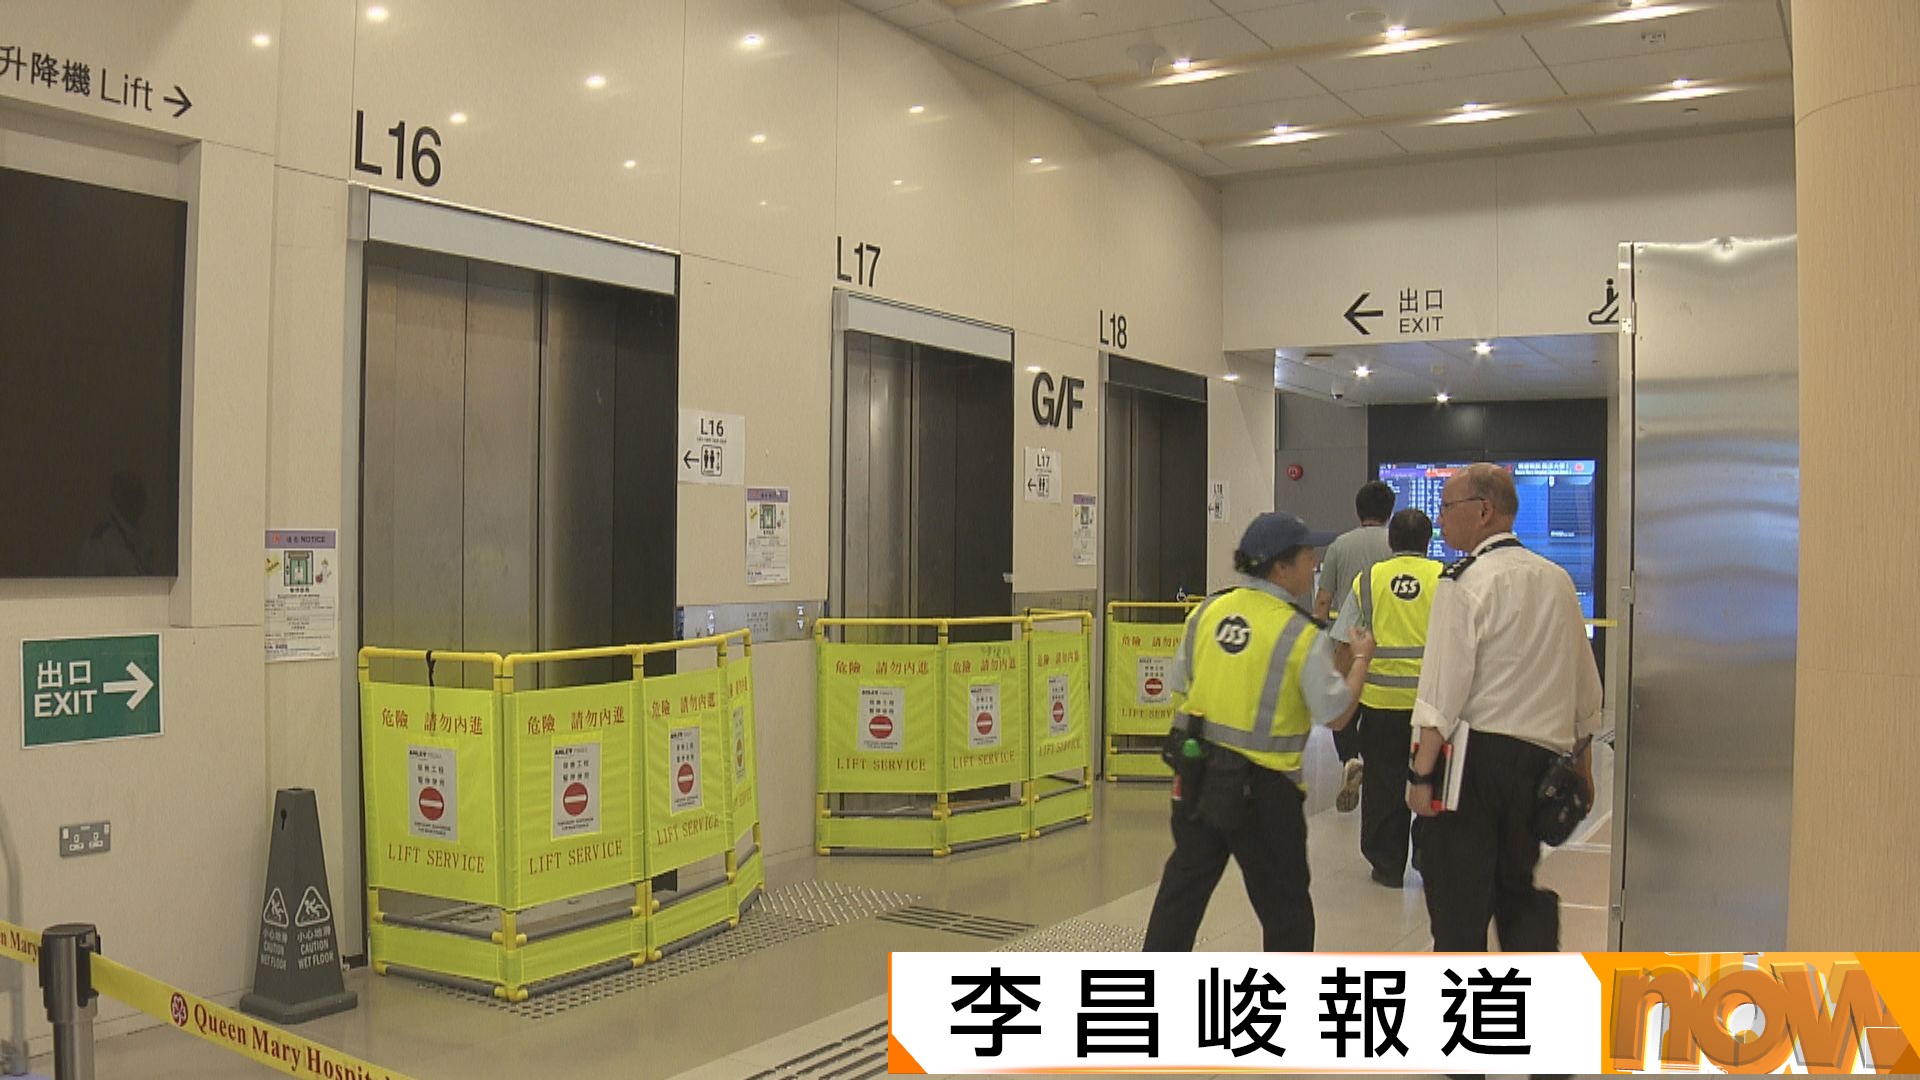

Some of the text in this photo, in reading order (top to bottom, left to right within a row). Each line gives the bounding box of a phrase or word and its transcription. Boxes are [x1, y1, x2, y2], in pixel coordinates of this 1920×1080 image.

[0, 46, 153, 111] 升降機 Lift
[355, 109, 442, 187] L16
[837, 236, 881, 288] L17
[1400, 287, 1443, 313] 出口
[1100, 310, 1128, 349] L18
[1400, 316, 1444, 334] EXIT
[1032, 371, 1085, 430] G/F
[700, 418, 724, 437] L16
[1036, 454, 1050, 467] L17
[1393, 579, 1418, 594] ISS
[1216, 624, 1252, 646] ISS
[38, 660, 91, 689] 出口
[835, 660, 861, 674] 危險
[34, 689, 98, 718] EXIT
[382, 707, 484, 736] 危險 請勿內進
[528, 705, 625, 736] 危險 請勿內進
[837, 757, 927, 771] LIFT SERVICE
[953, 750, 1016, 769] LIFT SERVICE
[657, 815, 719, 847] LIFT SERVICE
[388, 843, 485, 874] LIFT SERVICE
[529, 839, 623, 876] LIFT SERVICE
[301, 938, 329, 955] CAUTION
[194, 1003, 390, 1080] Queen Mary Hospit
